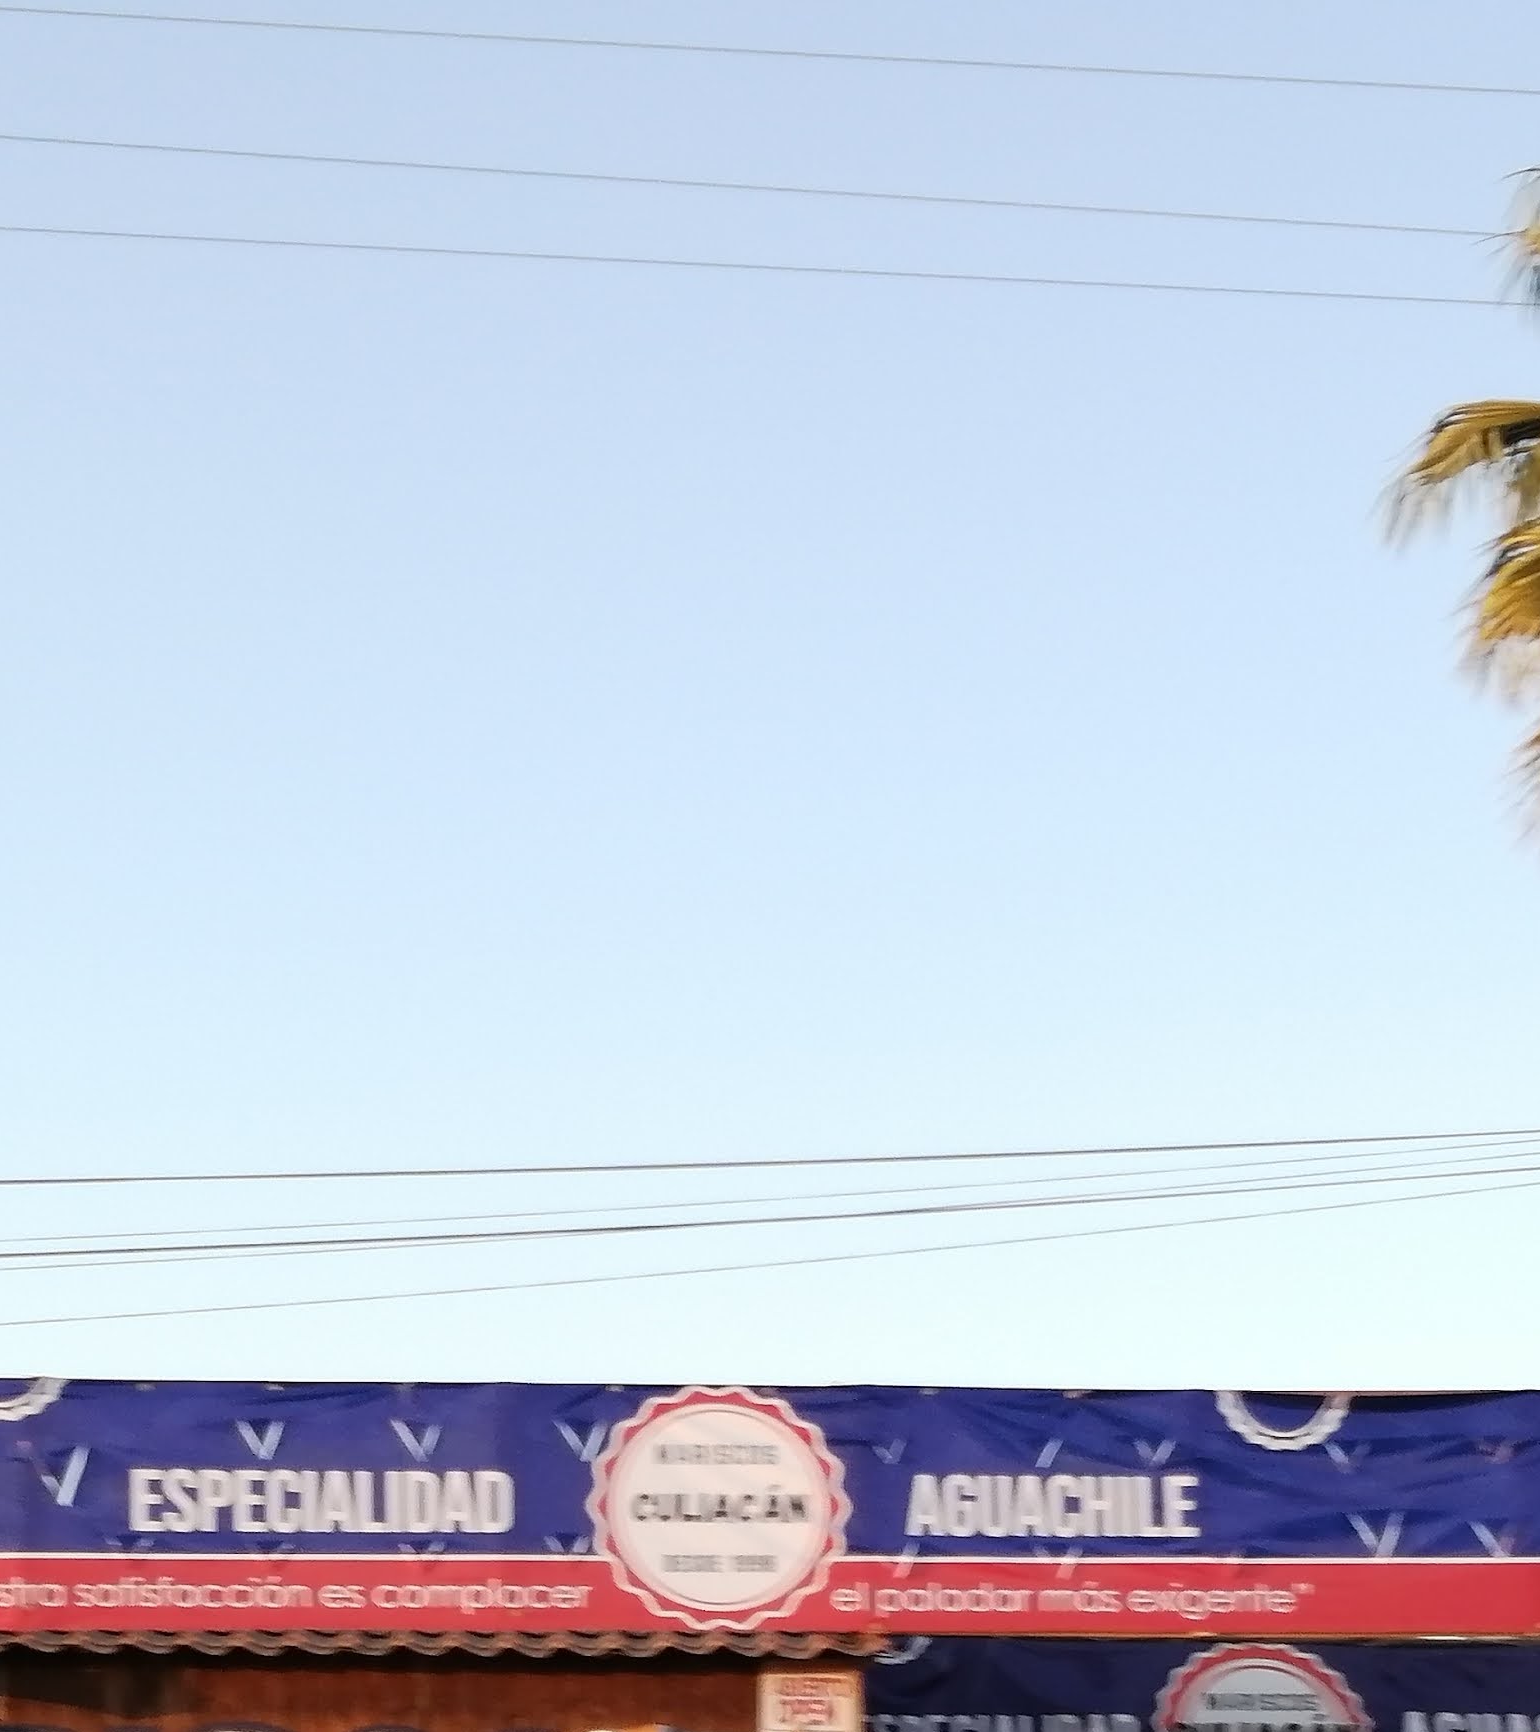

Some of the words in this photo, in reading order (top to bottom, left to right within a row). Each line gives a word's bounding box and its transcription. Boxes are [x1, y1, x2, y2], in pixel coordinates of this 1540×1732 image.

[128, 1468, 515, 1534] ESPECIALIDAD
[631, 1484, 810, 1523] CULIACÁN
[904, 1474, 1201, 1538] AGUACHILE
[318, 1584, 366, 1608] es
[371, 1578, 594, 1615] complacer
[830, 1582, 870, 1611] el
[875, 1582, 1034, 1617] paladar
